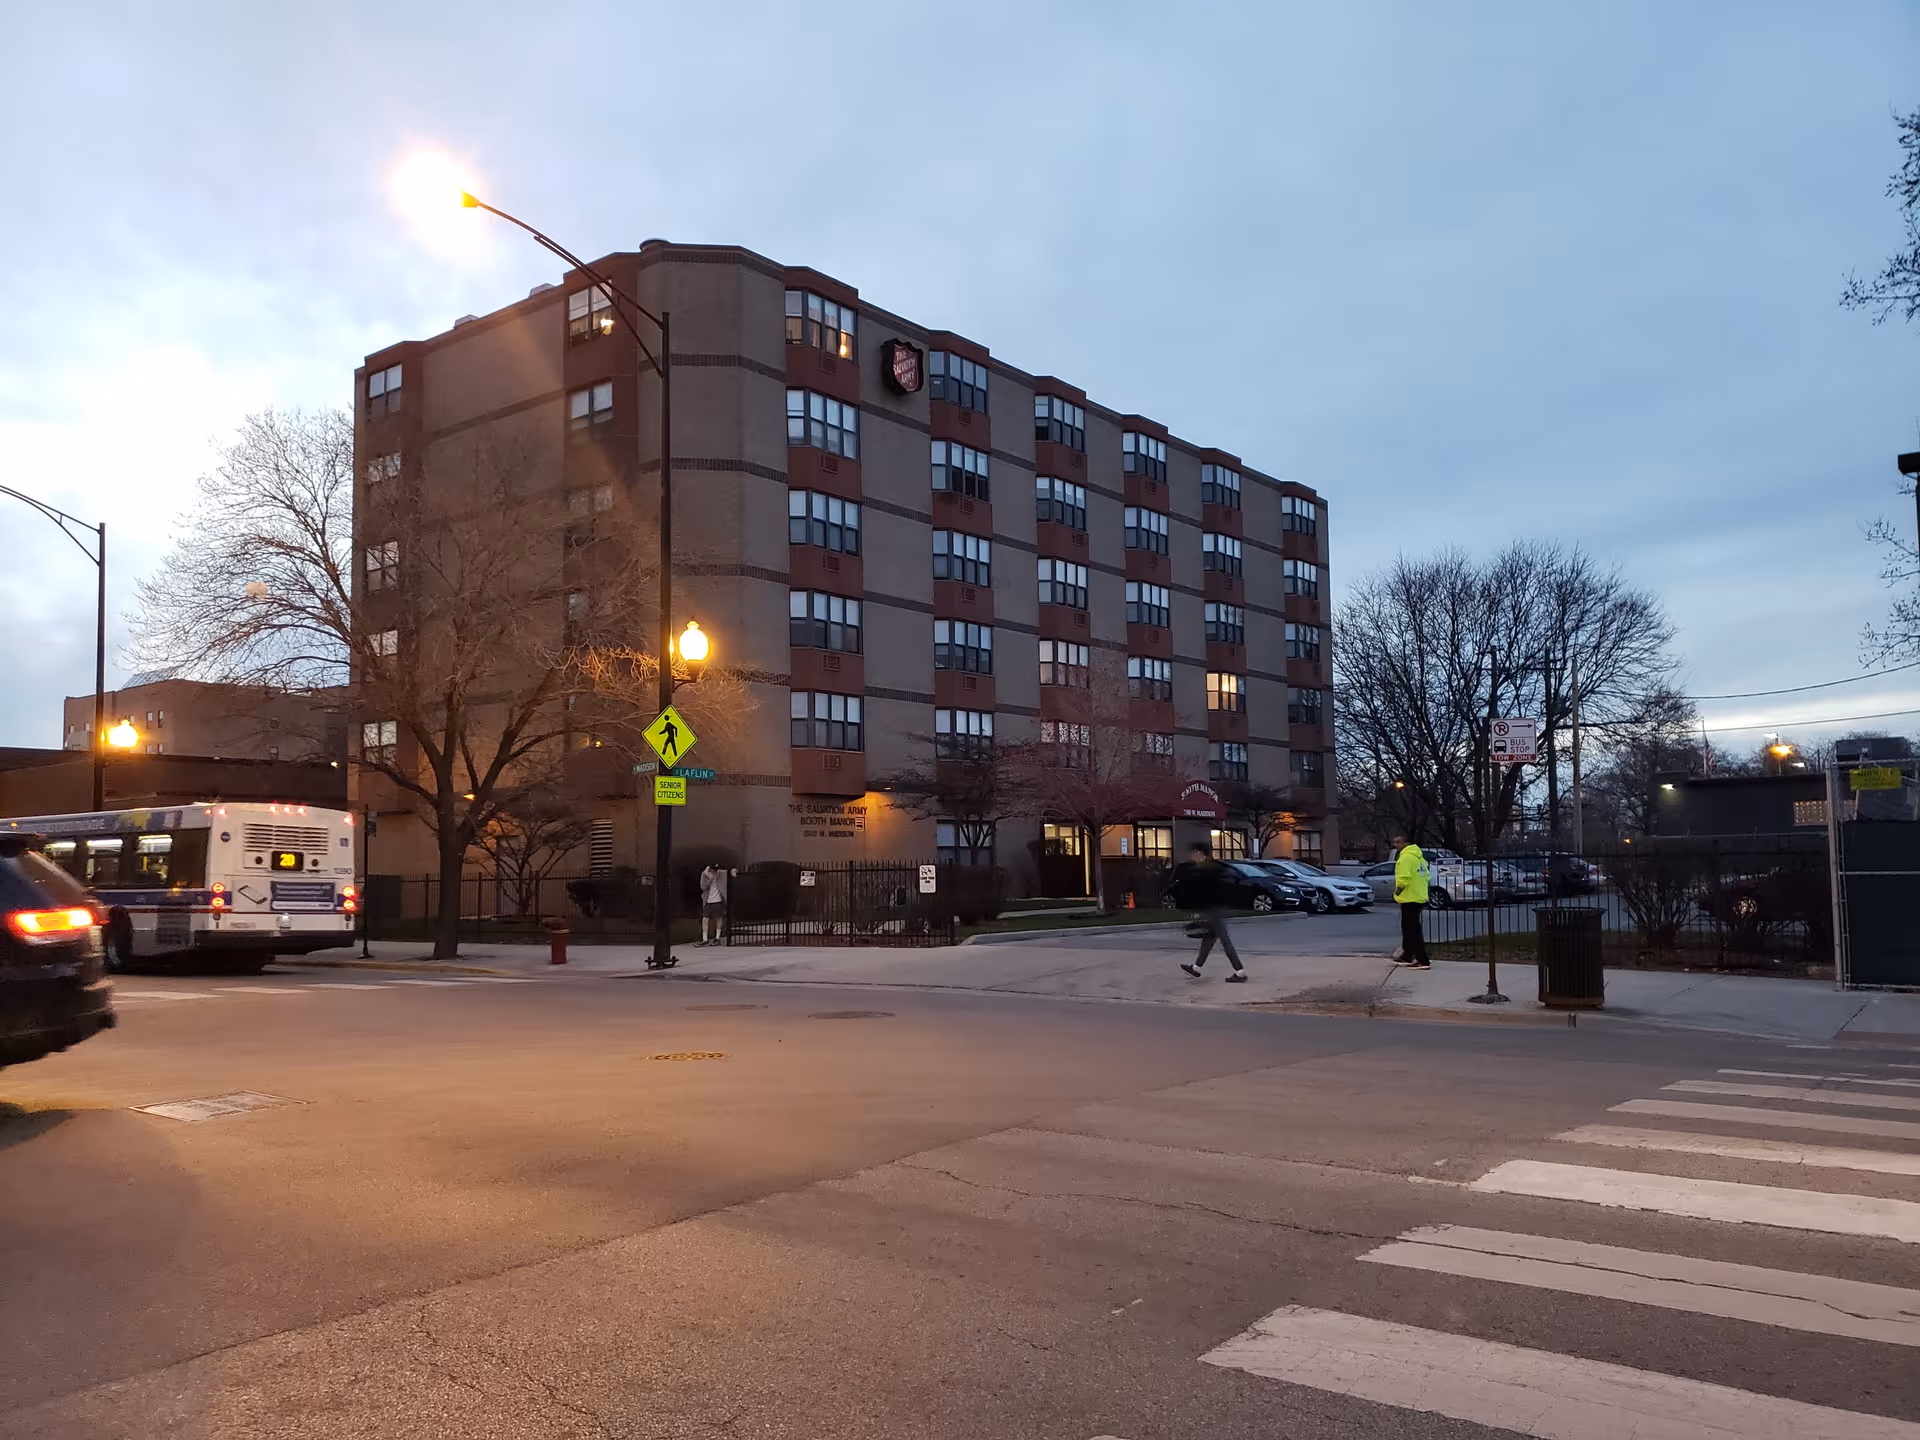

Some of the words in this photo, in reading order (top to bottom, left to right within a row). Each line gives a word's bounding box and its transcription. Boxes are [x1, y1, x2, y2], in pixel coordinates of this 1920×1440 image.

[680, 768, 708, 778] LAFLIN
[659, 781, 682, 789] SENIOR
[657, 791, 684, 799] CITIZENS
[788, 804, 804, 814] THE
[806, 804, 845, 815] SALVATION
[847, 806, 868, 815] ARMY
[800, 816, 827, 826] BOOTH
[829, 817, 856, 827] MANOR
[280, 853, 295, 866] 20
